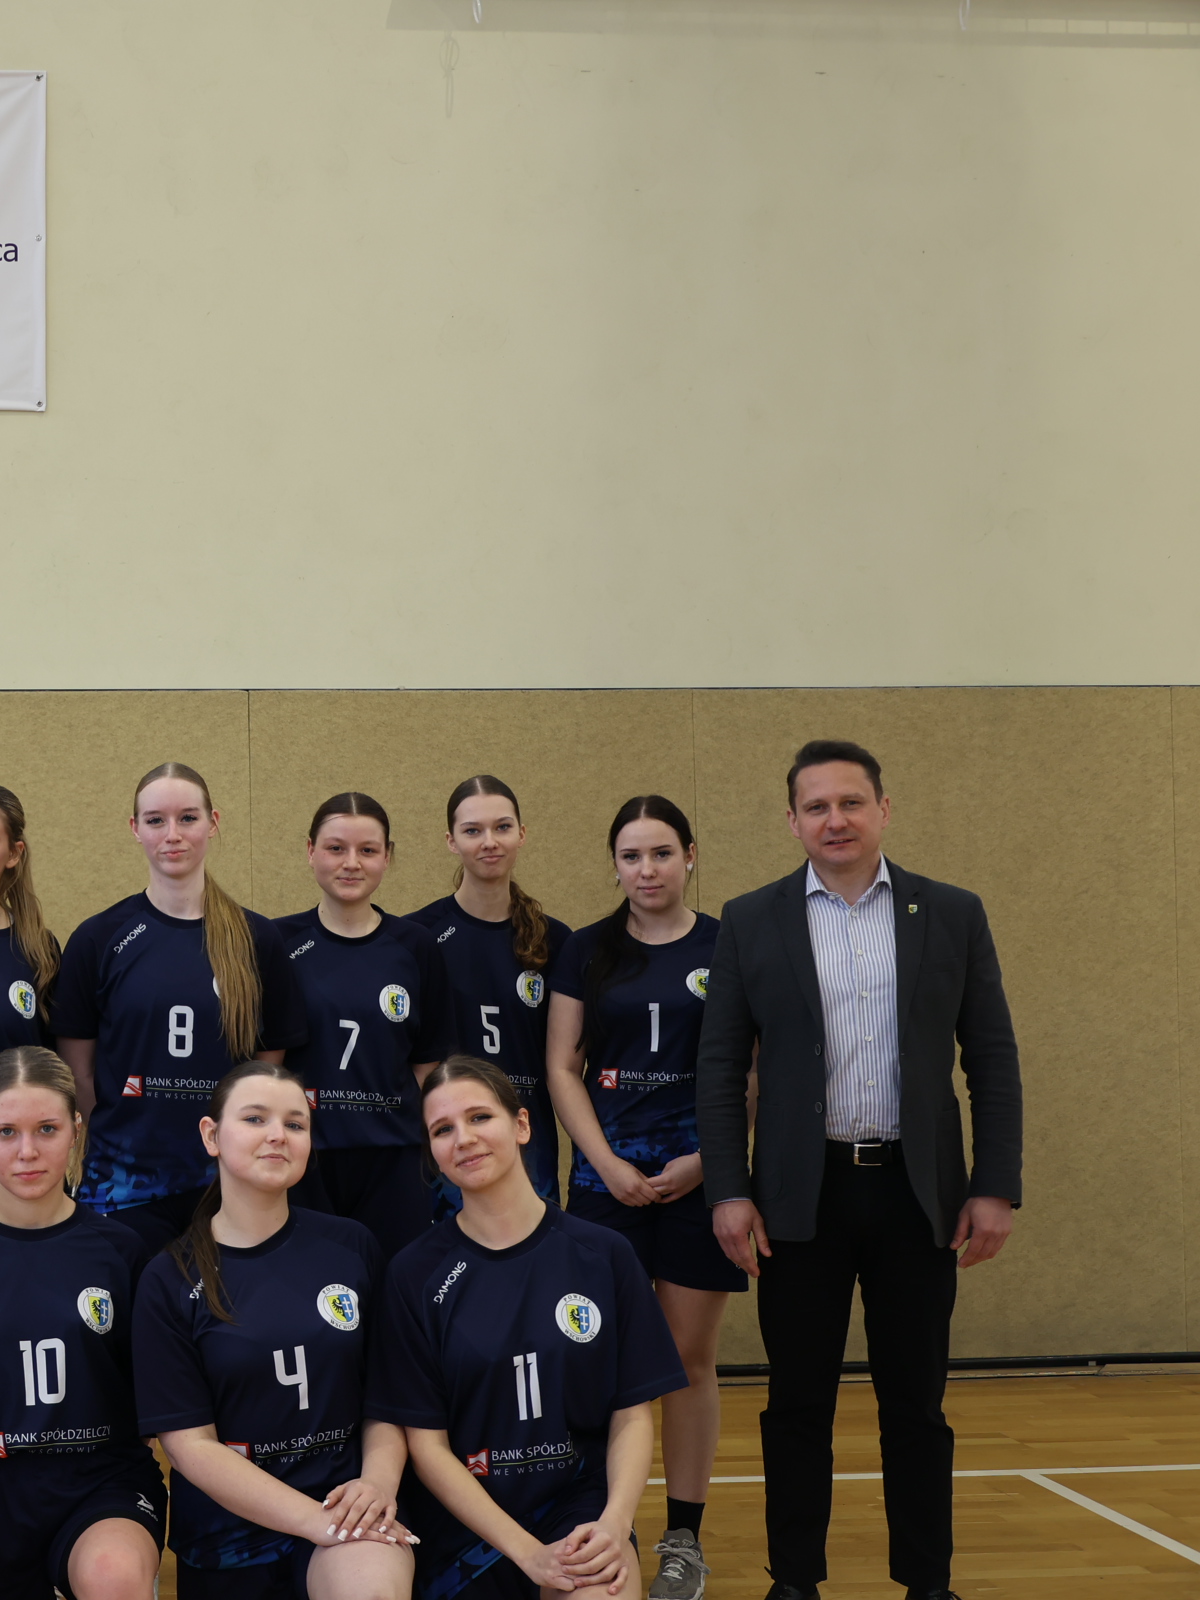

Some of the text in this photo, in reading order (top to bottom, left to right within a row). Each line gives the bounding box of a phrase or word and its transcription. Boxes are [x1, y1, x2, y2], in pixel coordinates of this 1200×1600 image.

[113, 922, 147, 954] DAMONS
[168, 1005, 194, 1058] 8
[480, 1005, 500, 1054] 5
[648, 1002, 660, 1052] 1
[339, 1019, 360, 1070] 7
[145, 1076, 172, 1087] BANK
[620, 1070, 645, 1081] BANK
[319, 1089, 346, 1099] BANK
[322, 1284, 350, 1294] POWIAT
[433, 1260, 467, 1304] DAMONS
[563, 1294, 591, 1305] POWIAT
[19, 1337, 66, 1406] 10
[272, 1345, 309, 1410] 4
[513, 1351, 542, 1421] 11
[4, 1425, 111, 1444] BANK SPÓŁDZIELCZY
[254, 1440, 288, 1454] BANK
[491, 1448, 524, 1461] BANK
[493, 1468, 509, 1476] WE
